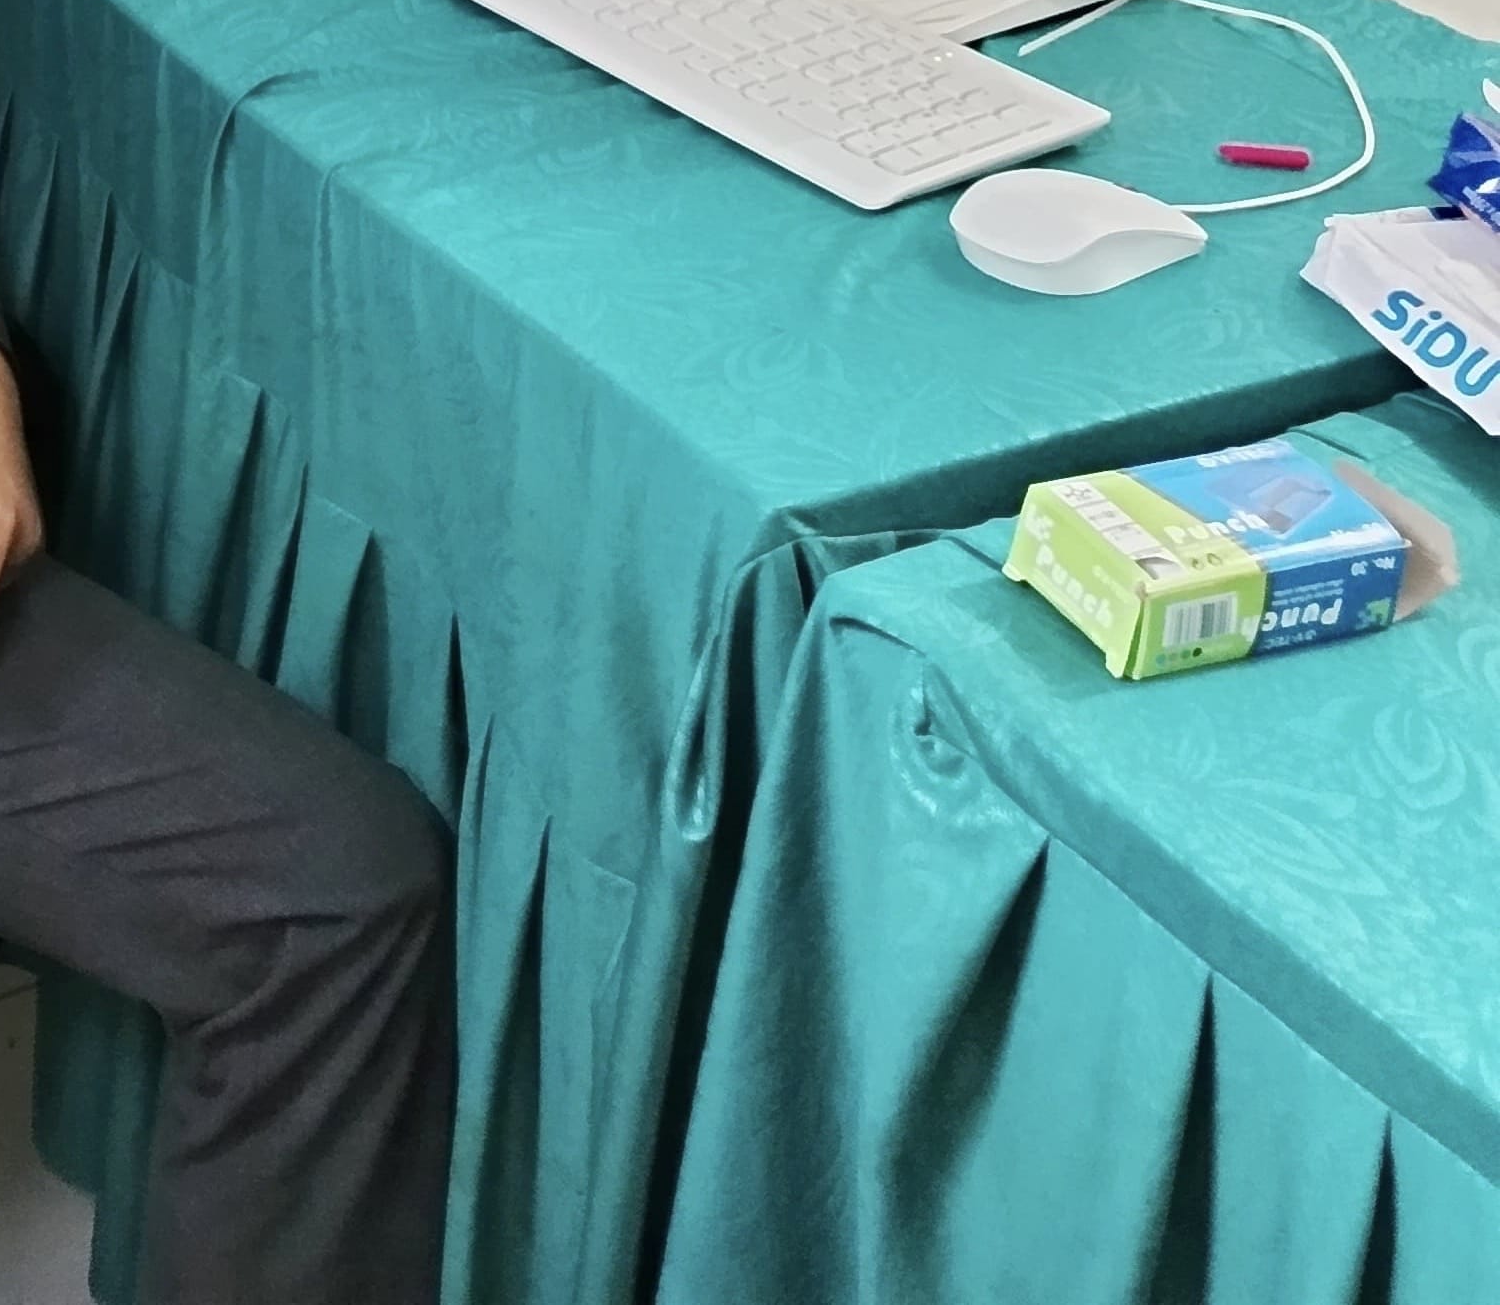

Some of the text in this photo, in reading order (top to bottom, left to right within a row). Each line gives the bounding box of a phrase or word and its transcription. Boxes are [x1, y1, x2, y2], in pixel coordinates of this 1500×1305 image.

[1371, 289, 1500, 397] SiDU
[1163, 510, 1270, 544] Punch
[1035, 544, 1113, 630] Punch
